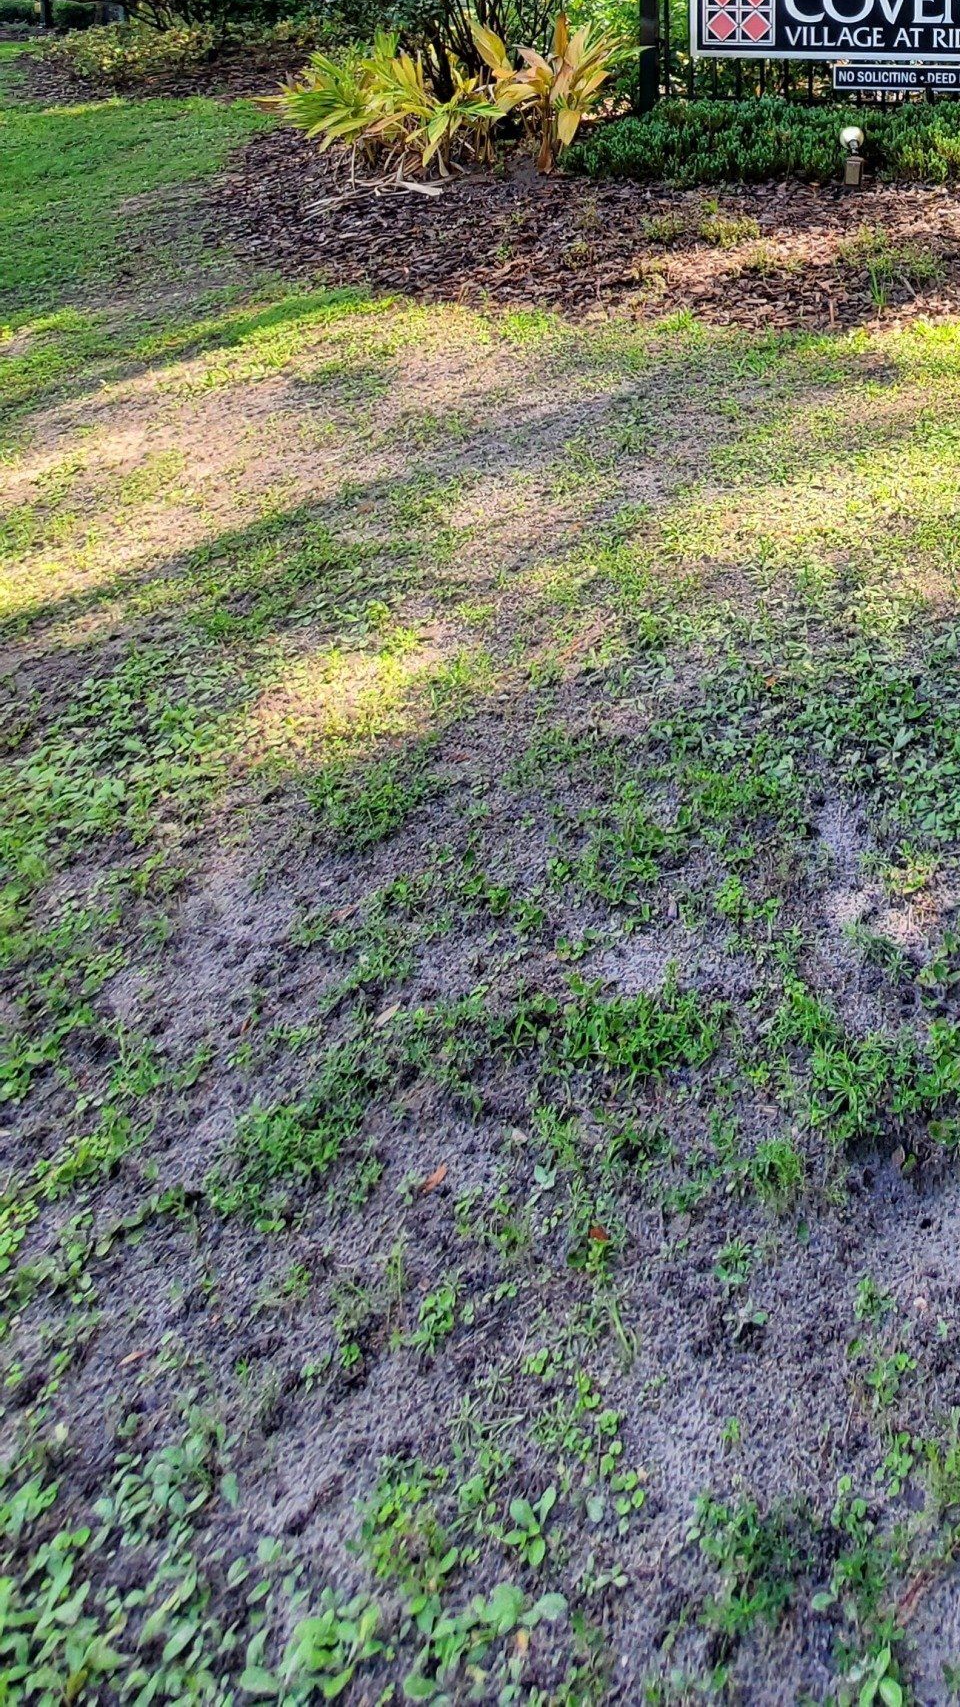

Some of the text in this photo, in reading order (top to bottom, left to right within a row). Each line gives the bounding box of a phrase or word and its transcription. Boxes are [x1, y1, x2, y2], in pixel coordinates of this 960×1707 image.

[785, 26, 885, 48] VILLAGE
[893, 27, 924, 49] AT
[838, 71, 855, 83] NO
[857, 71, 917, 83] SOLICITING
[927, 72, 956, 84] DEED
